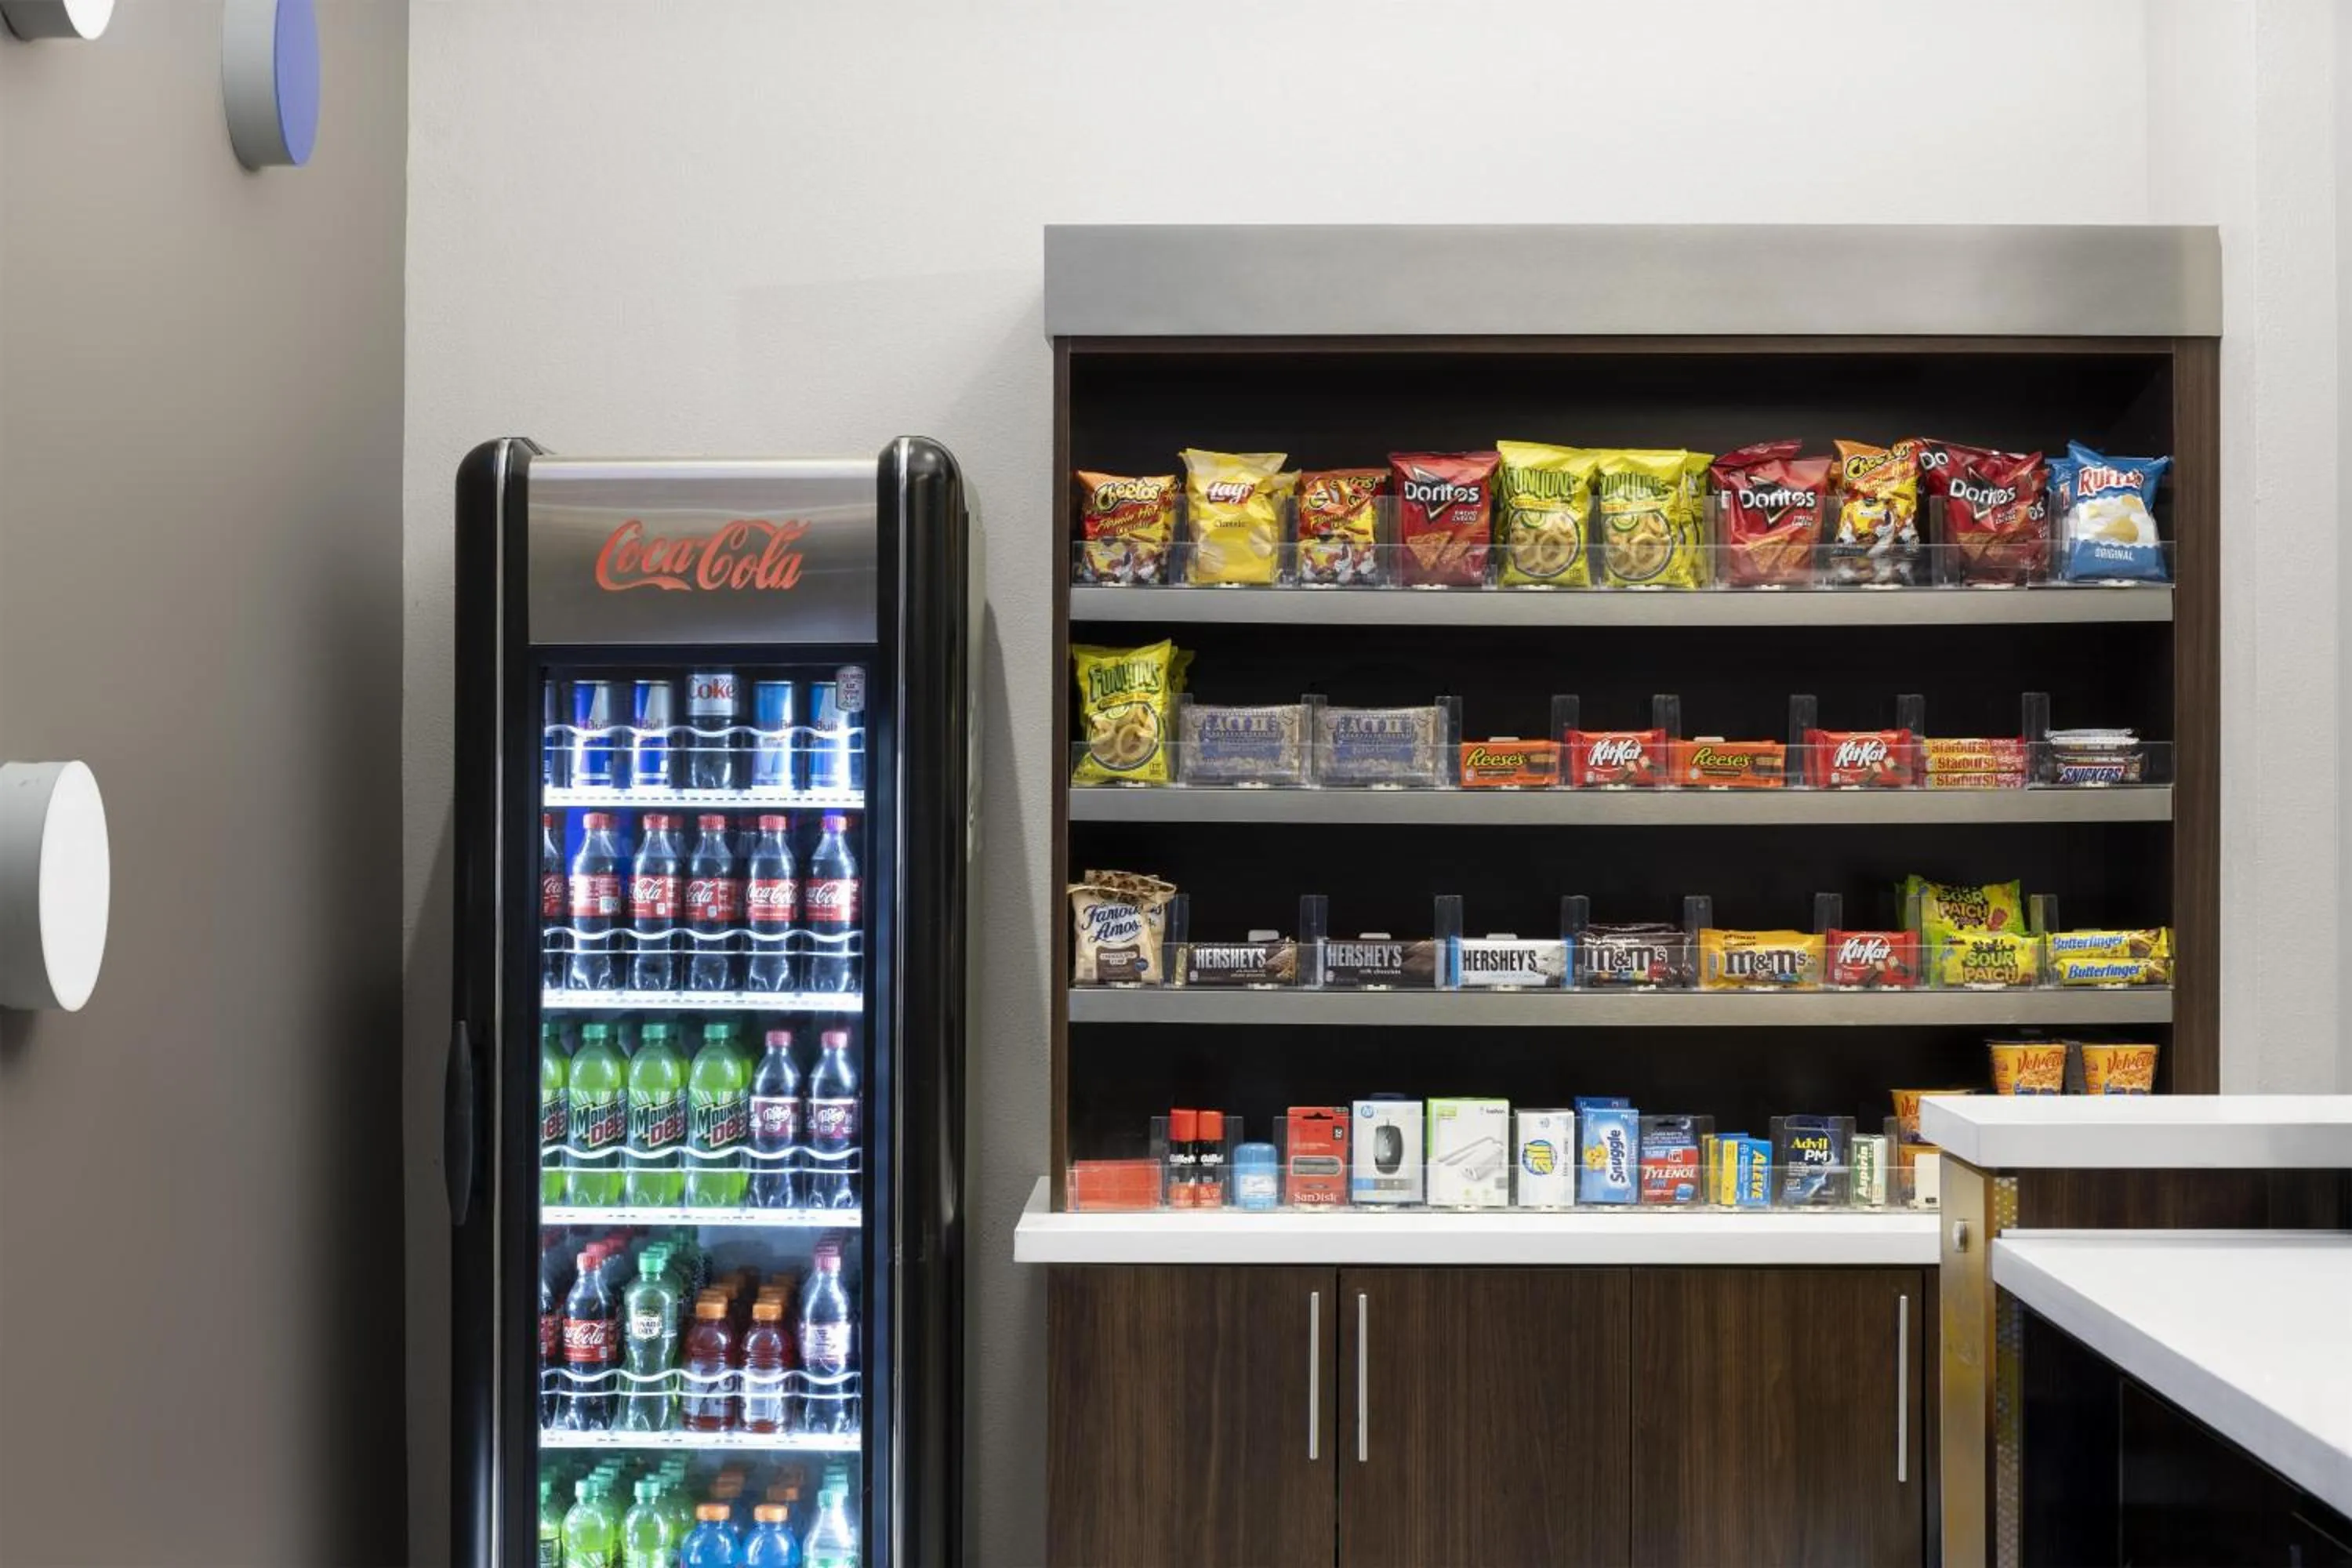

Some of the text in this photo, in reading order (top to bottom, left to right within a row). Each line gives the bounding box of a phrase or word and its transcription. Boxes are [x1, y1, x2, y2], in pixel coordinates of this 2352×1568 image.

[1094, 480, 1161, 512] Cheetos
[1404, 481, 1480, 502] Doritos
[1739, 488, 1816, 509] Doritos
[1950, 478, 2016, 505] Doritos
[595, 518, 811, 591] Coca-Cola
[2060, 765, 2124, 783] SNICKERS
[1196, 948, 1266, 969] HERSHEY'S
[1327, 945, 1403, 967] HERSHEY'S
[1463, 949, 1537, 971] HERSHEY'S
[1966, 951, 2016, 967] SOUR
[2068, 964, 2142, 980] Butterfinger
[1791, 1138, 1828, 1149] Advil
[1610, 1129, 1626, 1183] Snuggle
[1804, 1149, 1828, 1161] PM
[1643, 1166, 1695, 1180] TYLENOL
[1751, 1149, 1767, 1200] ALEVE
[1857, 1145, 1871, 1197] Aspirin
